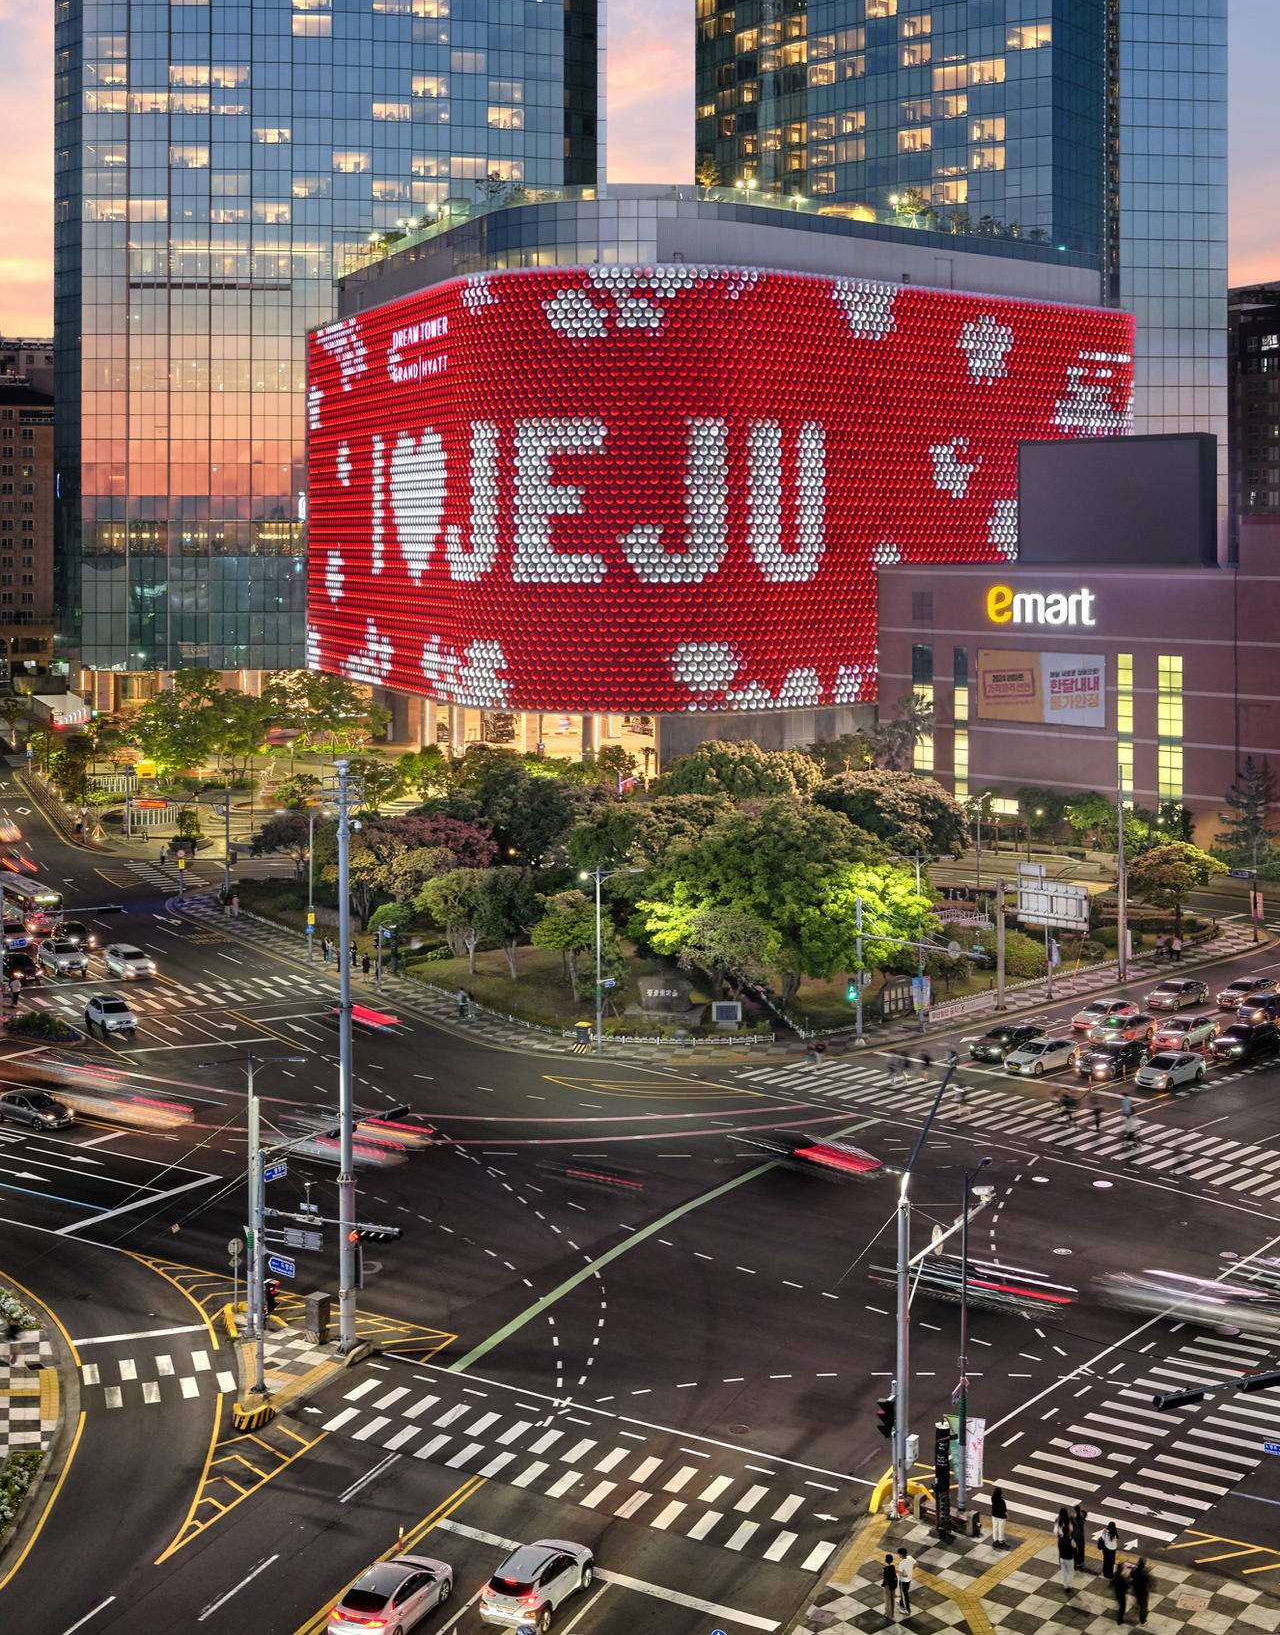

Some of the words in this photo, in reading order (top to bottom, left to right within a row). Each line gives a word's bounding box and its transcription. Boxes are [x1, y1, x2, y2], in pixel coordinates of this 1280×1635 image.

[392, 325, 419, 349] DREAM
[420, 316, 449, 341] TOWER
[392, 364, 418, 383] GRAND
[421, 355, 448, 376] HYATT
[444, 417, 827, 584] JEJU
[987, 585, 1096, 626] emart
[1050, 676, 1100, 694] 한달내내
